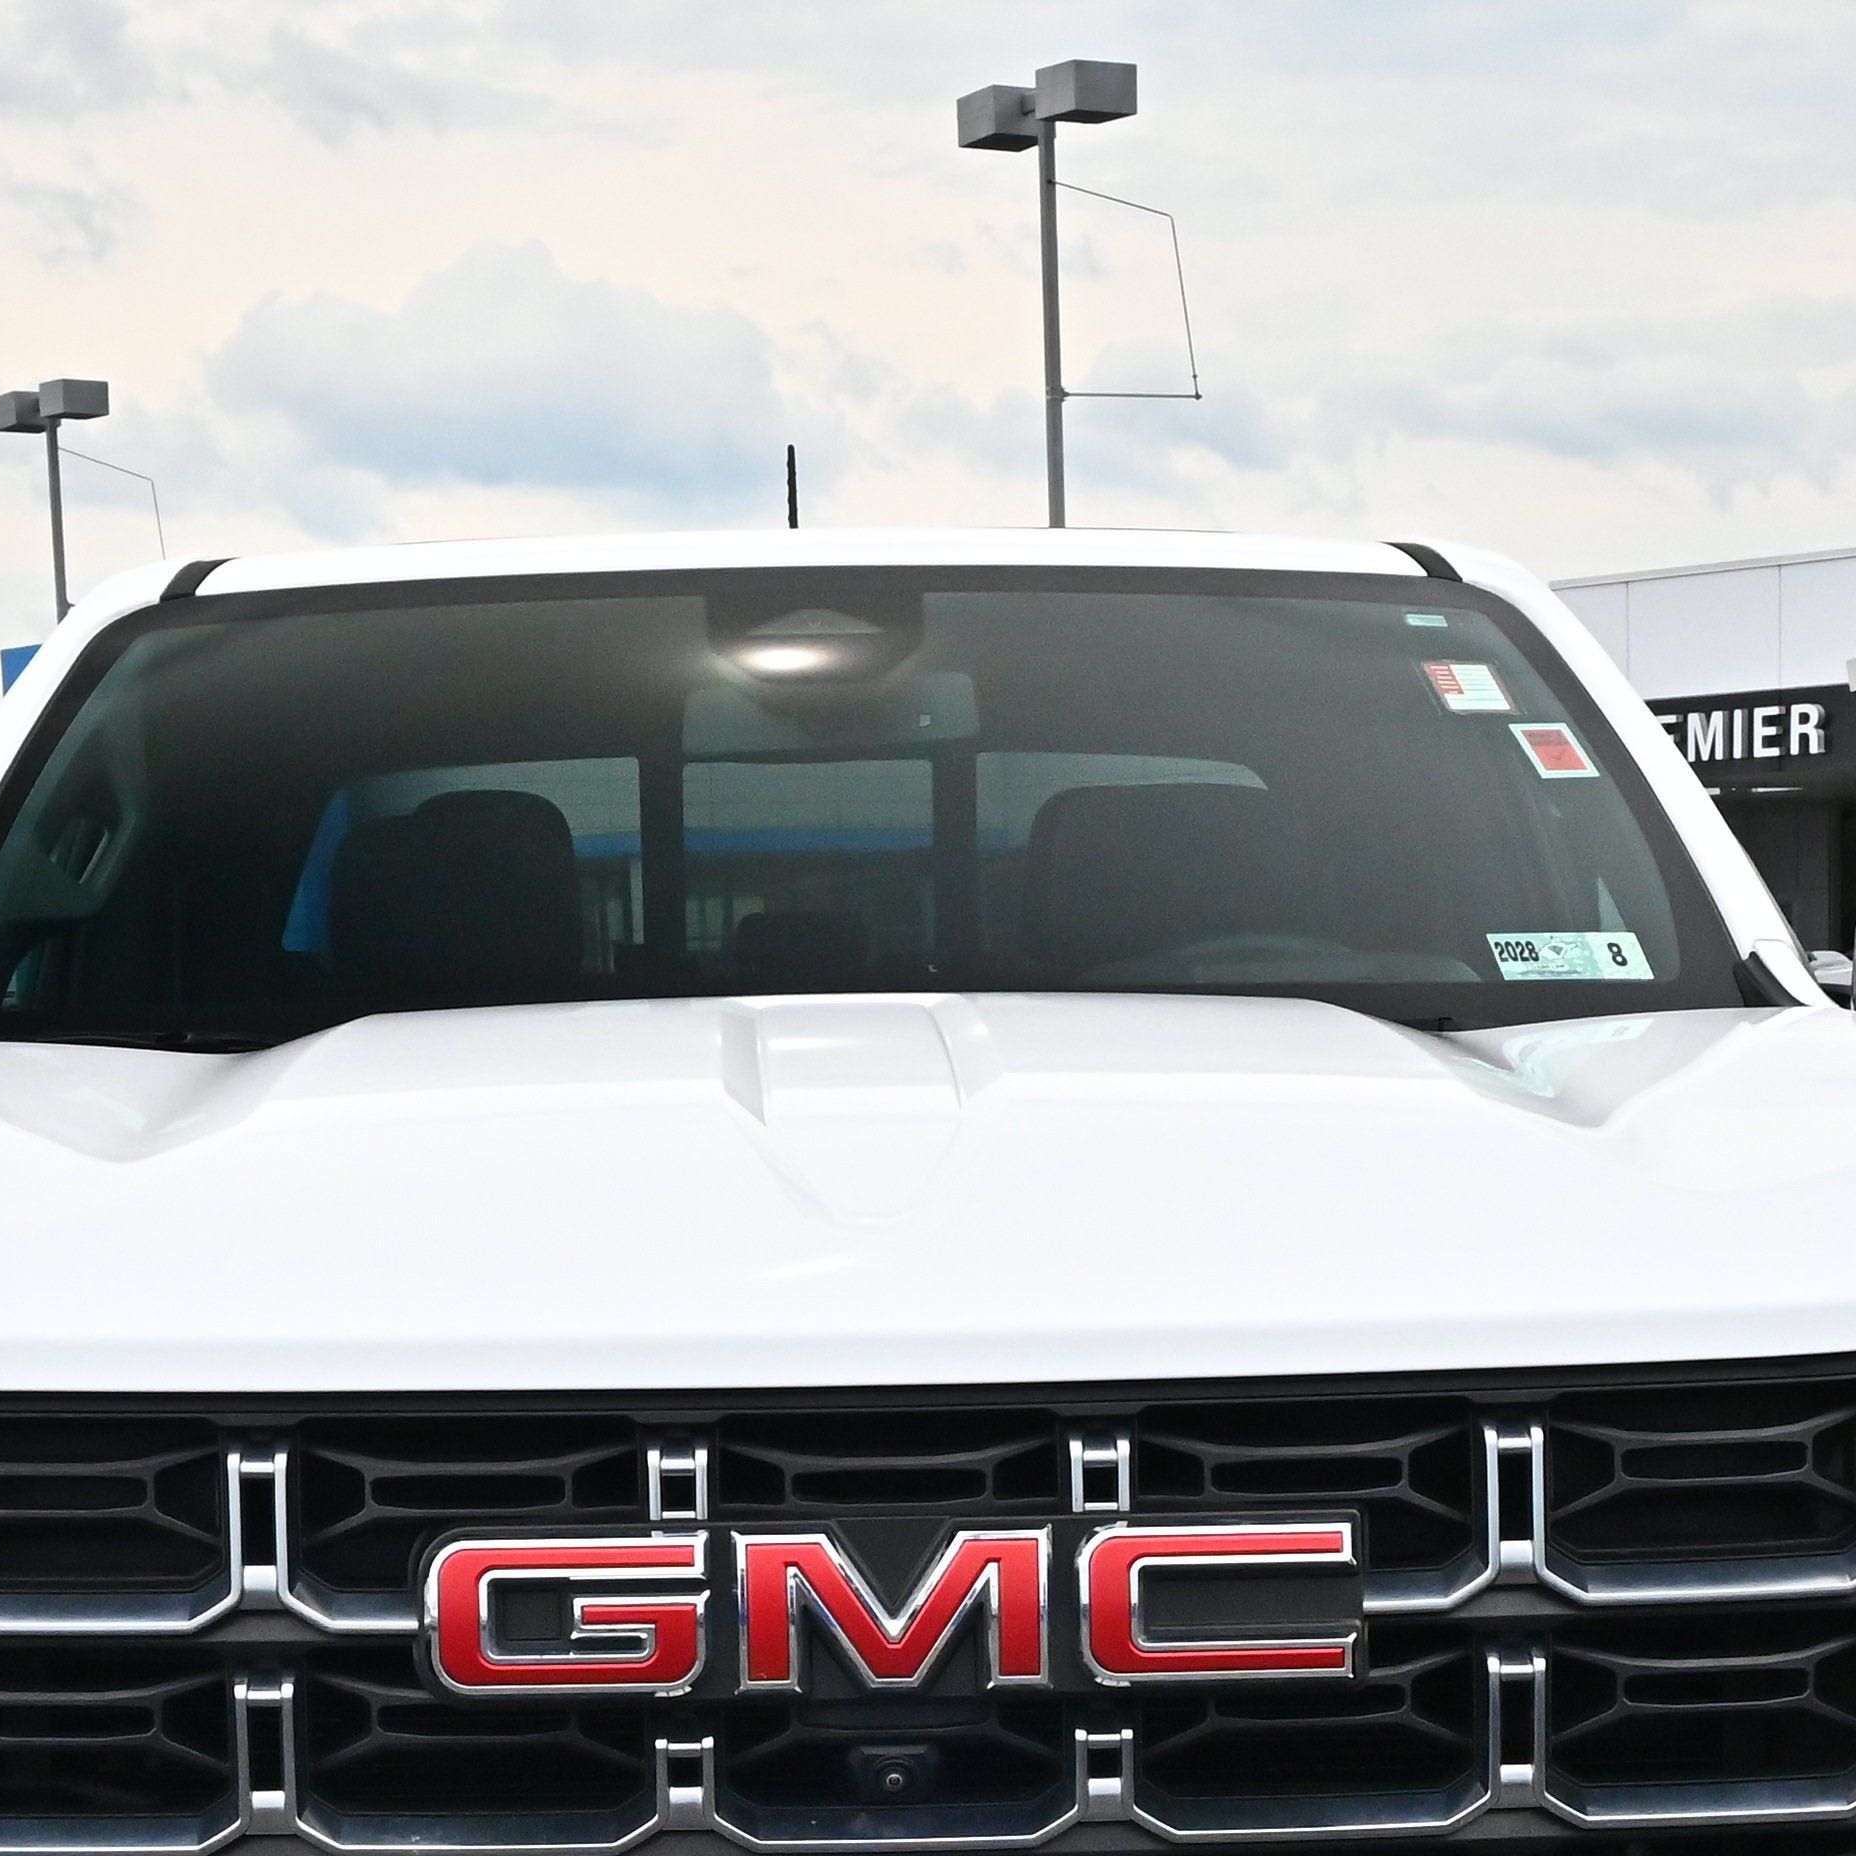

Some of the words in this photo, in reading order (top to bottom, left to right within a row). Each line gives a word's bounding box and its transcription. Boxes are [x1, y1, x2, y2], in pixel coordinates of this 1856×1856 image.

[1494, 940, 1540, 962] 2028
[1607, 942, 1628, 967] 8
[425, 1523, 1358, 1694] GMC
